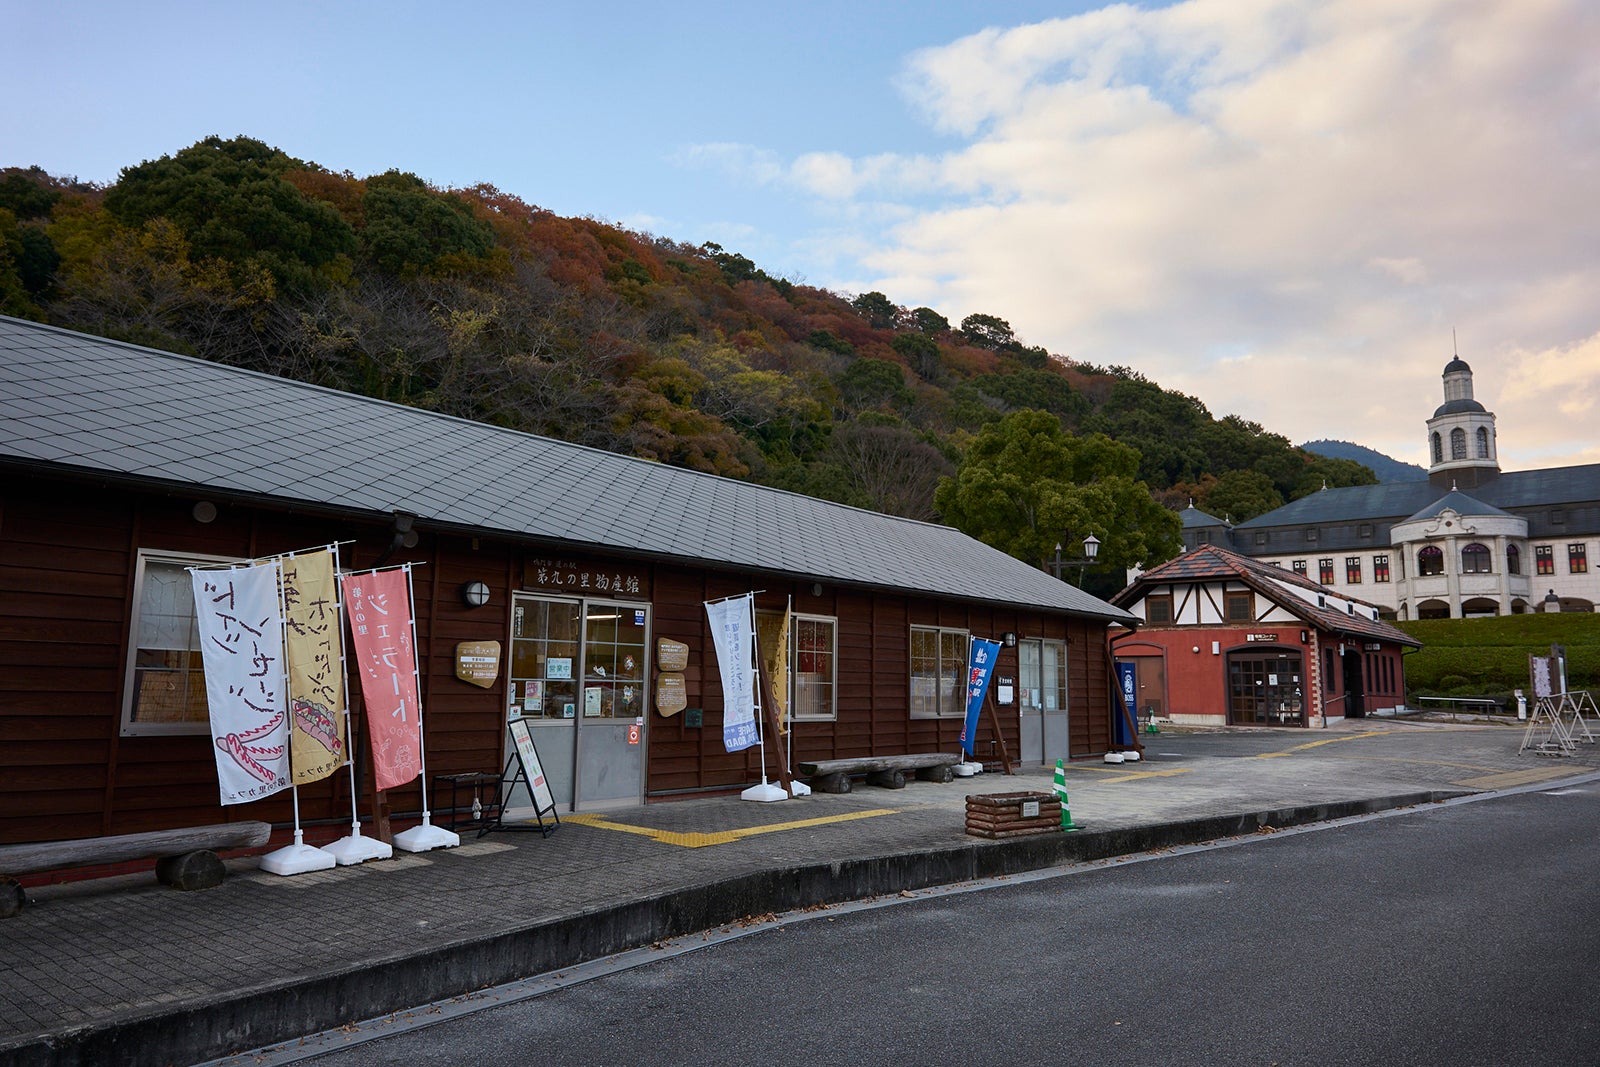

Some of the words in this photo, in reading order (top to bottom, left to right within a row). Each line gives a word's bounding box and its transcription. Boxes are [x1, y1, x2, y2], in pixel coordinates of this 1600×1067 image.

[537, 567, 640, 594] 第九の里物産館
